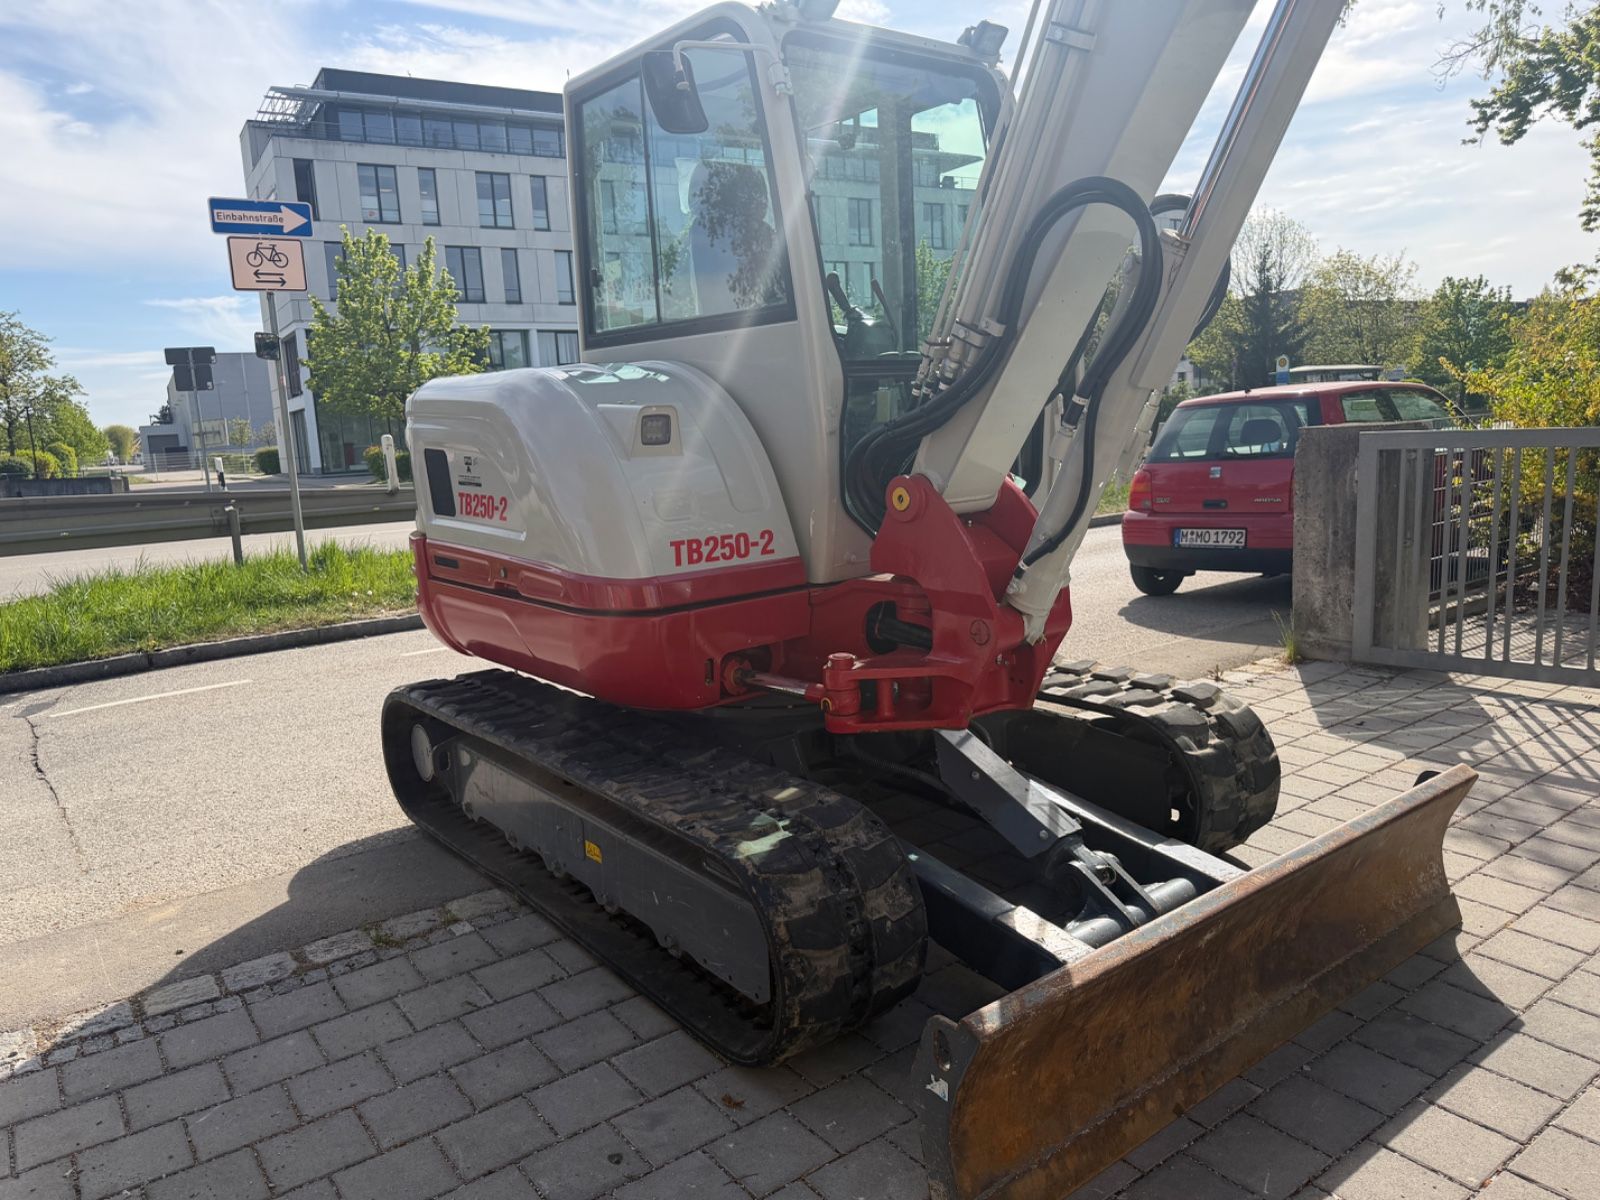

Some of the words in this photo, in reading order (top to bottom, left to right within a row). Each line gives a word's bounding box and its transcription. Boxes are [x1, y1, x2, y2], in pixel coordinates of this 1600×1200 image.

[216, 211, 284, 223] Einbahnstraße
[458, 492, 508, 521] TB250-2
[669, 529, 775, 567] TB250-2
[1213, 531, 1244, 544] 1792
